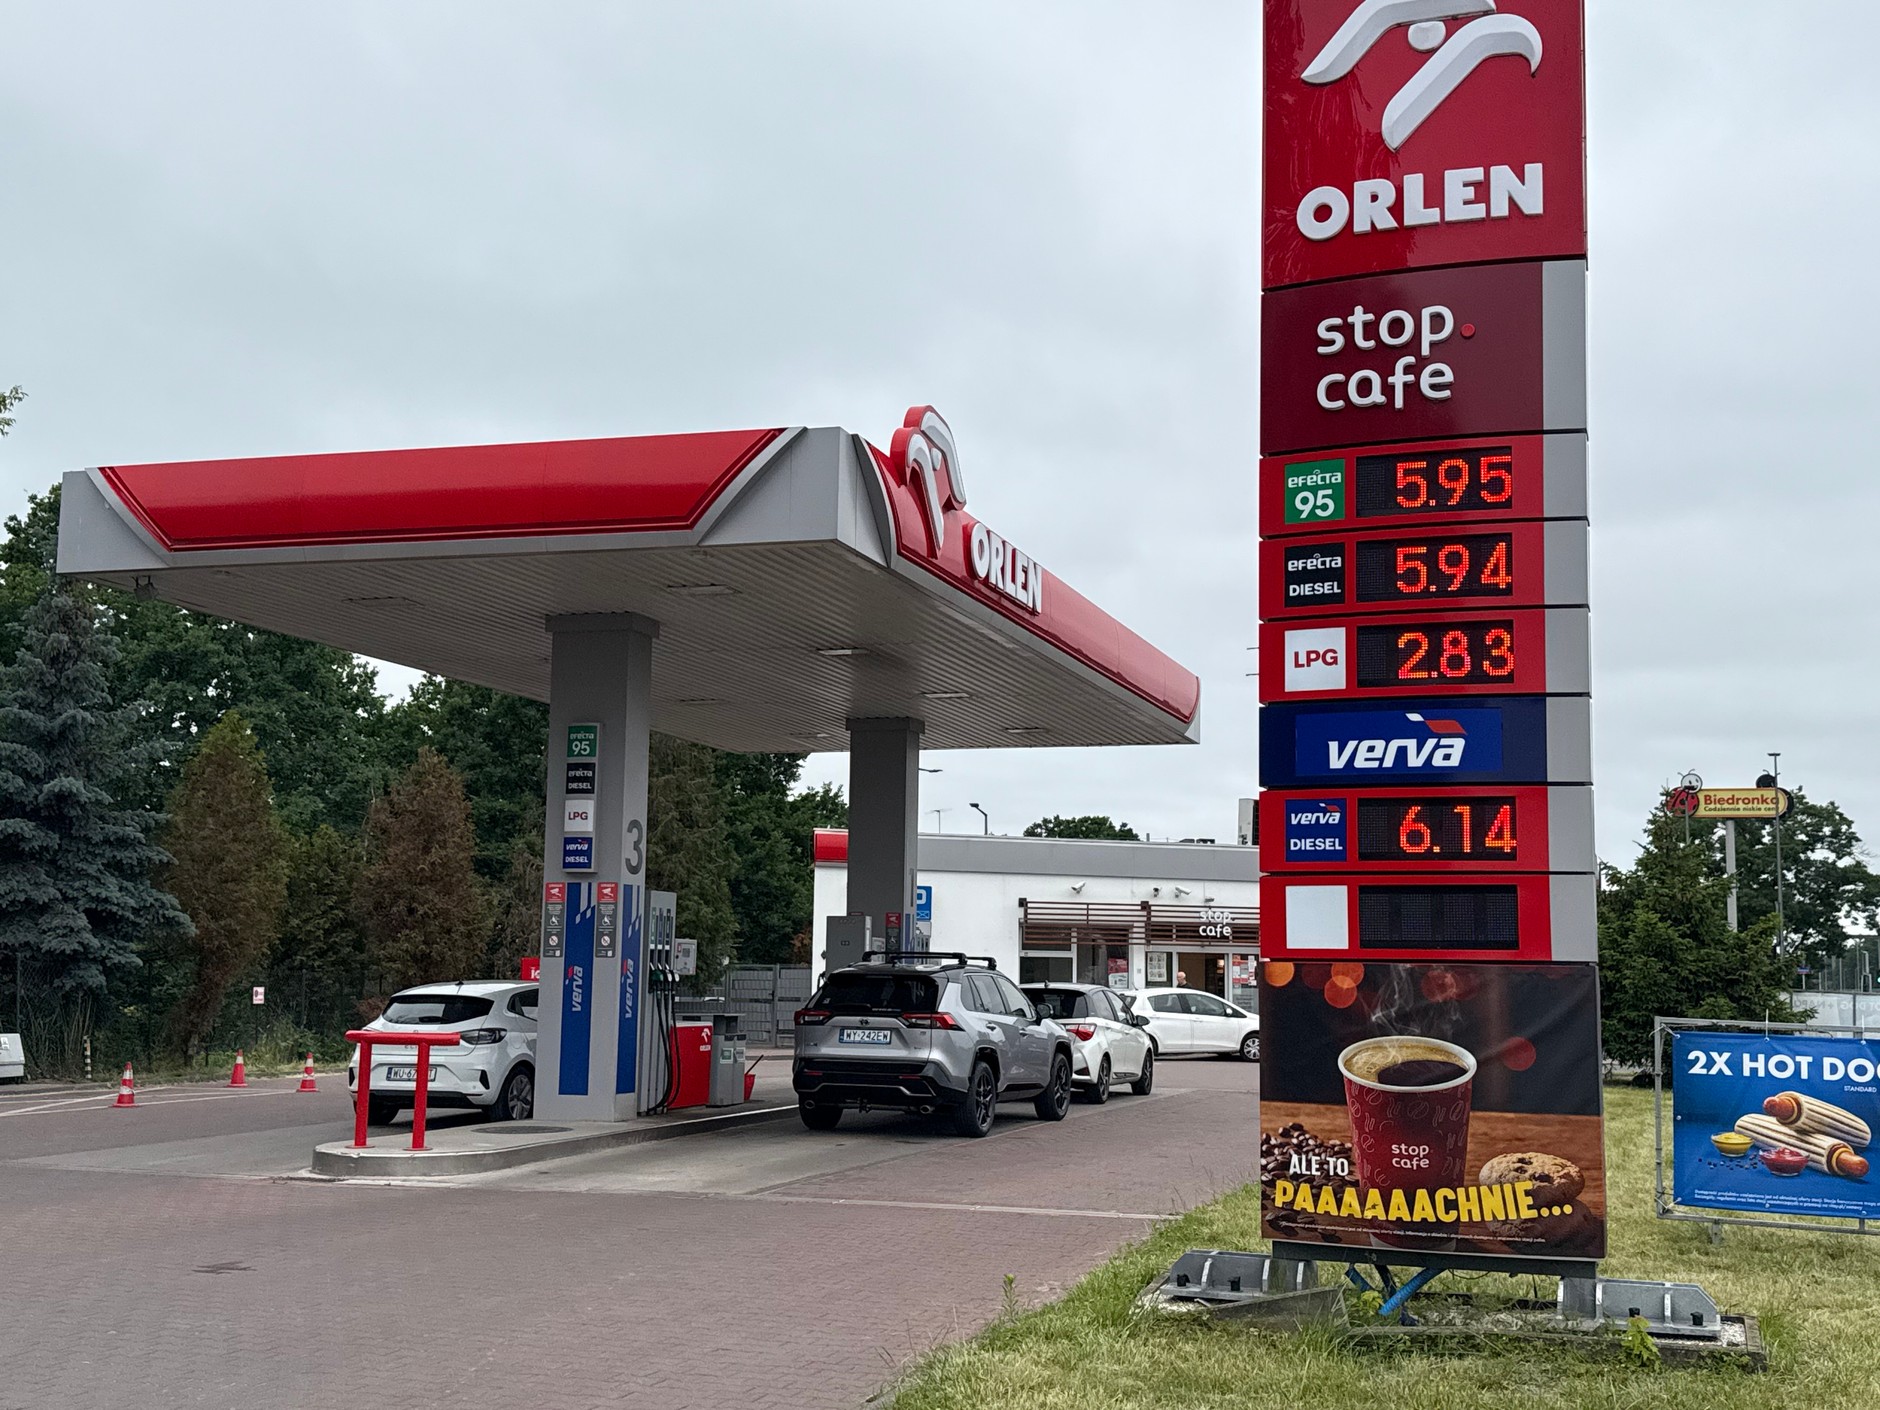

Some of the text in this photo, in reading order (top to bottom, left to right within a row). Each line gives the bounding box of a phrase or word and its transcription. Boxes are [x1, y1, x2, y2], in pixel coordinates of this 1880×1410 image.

[1297, 163, 1543, 241] ORLEN
[1317, 356, 1454, 410] cafe
[1396, 455, 1512, 508] 5.95
[1294, 488, 1335, 519] 95
[971, 522, 1043, 614] ORLEN
[1396, 541, 1512, 593] 5.94
[1289, 581, 1342, 598] DIESEL
[1293, 648, 1339, 669] LPG
[1397, 628, 1515, 680] 2.83
[572, 741, 590, 755] 95
[1328, 736, 1466, 770] verva
[568, 782, 592, 790] DIESEL
[568, 811, 588, 821] LPG
[1290, 810, 1341, 826] verva
[1399, 804, 1518, 854] 6.14
[565, 843, 588, 851] verva
[625, 818, 644, 875] 3
[1290, 837, 1343, 851] DIESEL
[1199, 924, 1232, 938] cafe
[571, 965, 583, 1012] verva
[1687, 1050, 1880, 1084] 2X HOT DO
[1843, 1085, 1877, 1093] STANDARD
[1391, 1143, 1429, 1158] stop
[1391, 1157, 1430, 1170] cafe
[1289, 1154, 1349, 1177] ALE TO
[1274, 1180, 1573, 1223] PAAAAAACHNIE...
